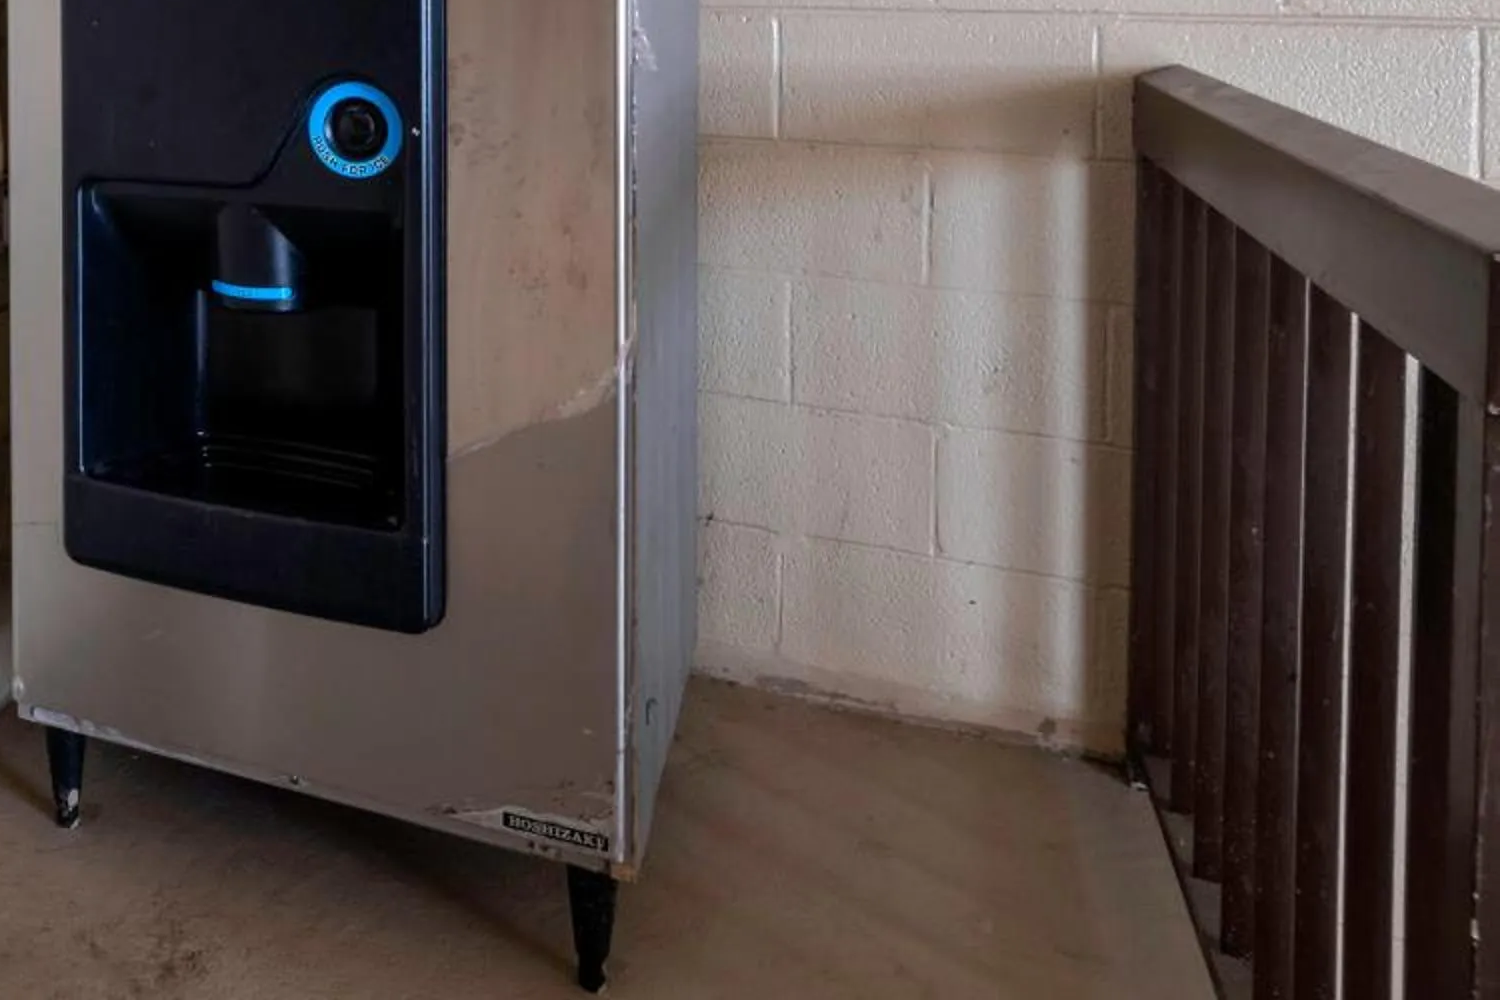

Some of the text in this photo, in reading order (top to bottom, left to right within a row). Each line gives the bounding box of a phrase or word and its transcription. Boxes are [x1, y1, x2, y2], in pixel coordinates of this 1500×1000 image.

[312, 135, 390, 176] PUSH FOR ICE
[508, 814, 606, 850] HOSHIZAKI
